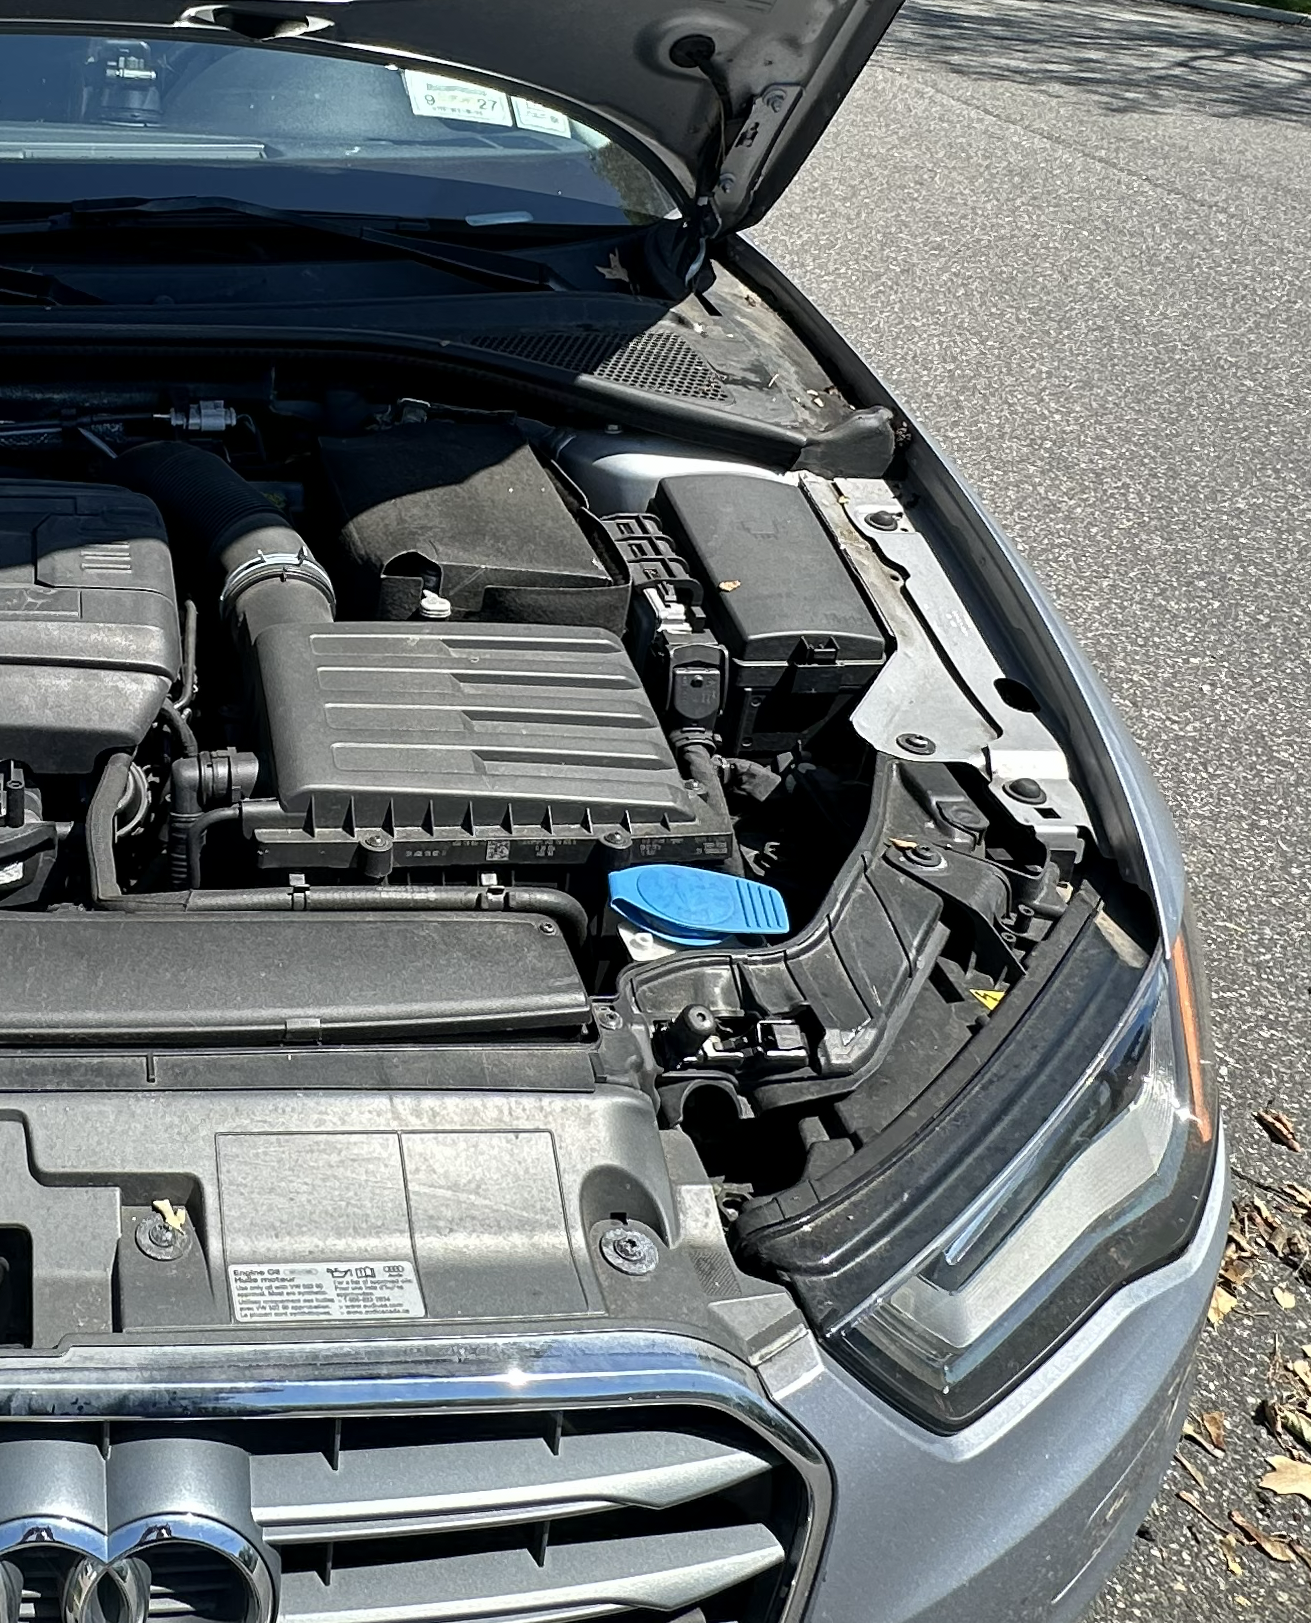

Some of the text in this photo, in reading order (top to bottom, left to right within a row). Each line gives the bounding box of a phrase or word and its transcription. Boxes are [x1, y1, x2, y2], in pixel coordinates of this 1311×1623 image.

[424, 94, 436, 106] 9
[477, 98, 498, 111] 27
[233, 1269, 265, 1278] Engine
